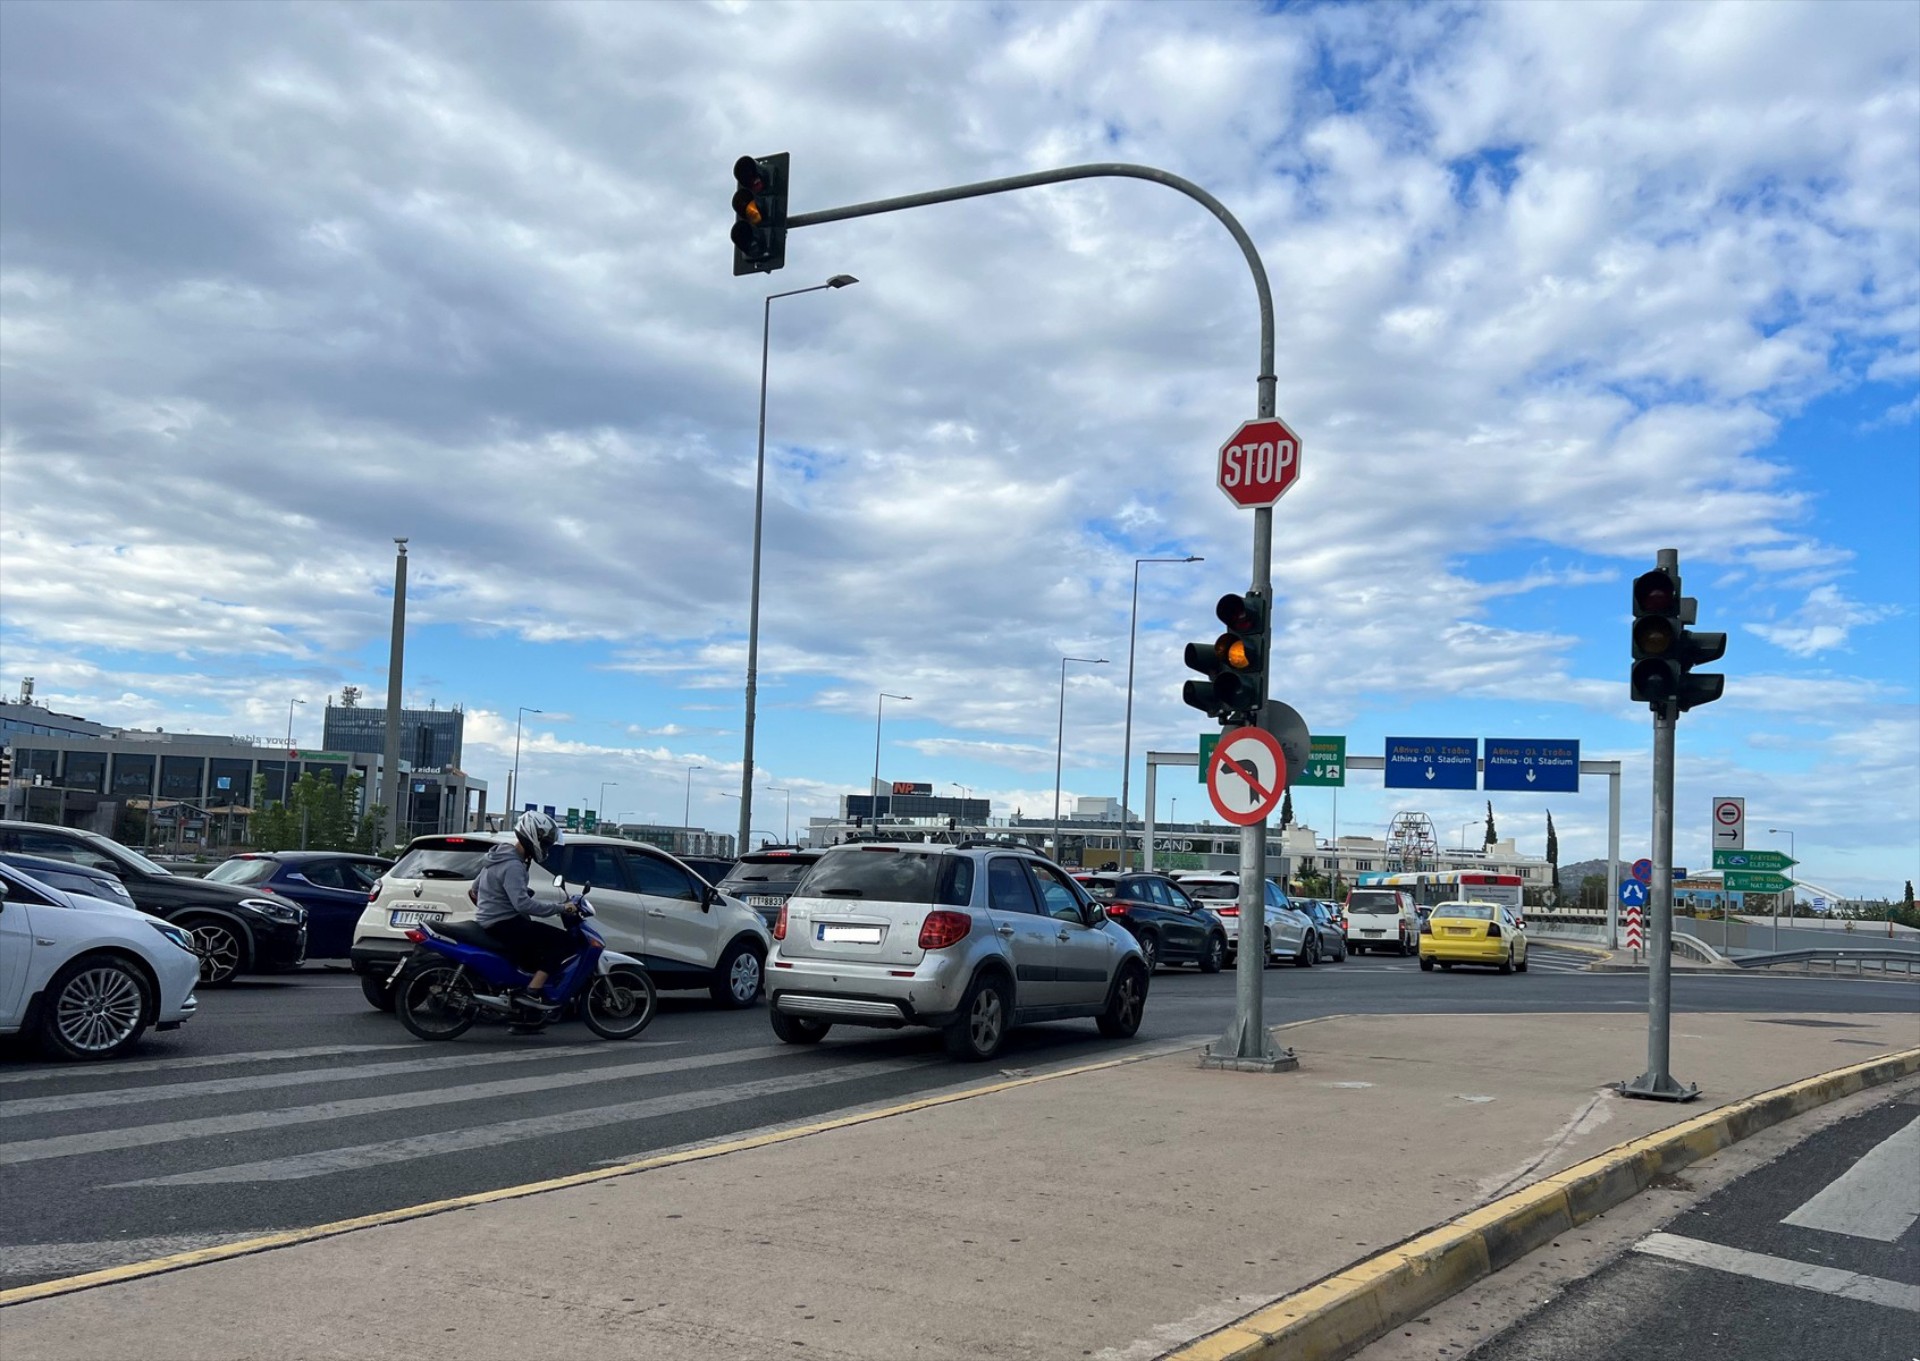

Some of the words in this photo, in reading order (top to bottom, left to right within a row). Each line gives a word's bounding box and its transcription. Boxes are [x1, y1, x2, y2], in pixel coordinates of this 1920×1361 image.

[1224, 439, 1294, 487] STOP
[266, 737, 297, 746] vovos
[1391, 755, 1417, 763] Athina
[1437, 755, 1471, 764] Stadium
[1538, 757, 1573, 765] Stadium
